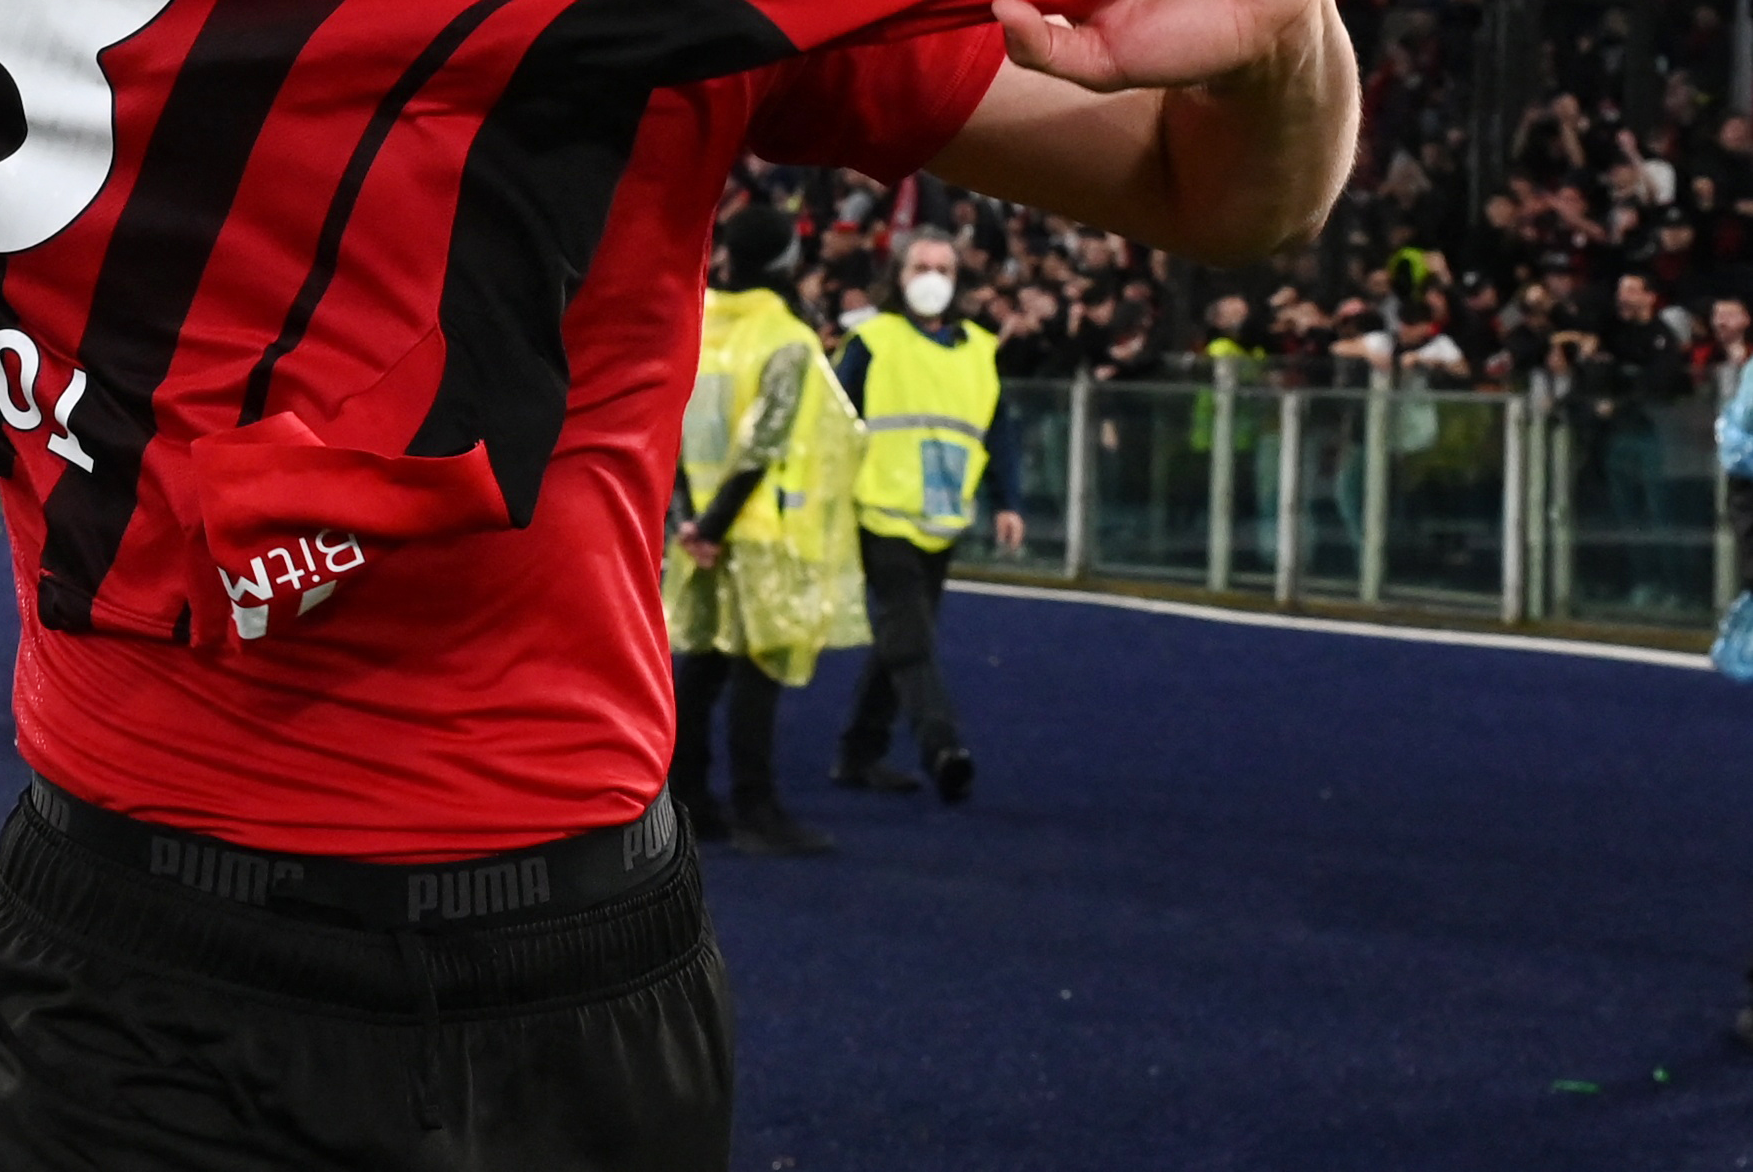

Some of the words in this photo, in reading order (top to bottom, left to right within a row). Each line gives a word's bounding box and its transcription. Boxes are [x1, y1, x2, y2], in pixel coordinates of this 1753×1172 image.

[217, 528, 366, 601] BitM
[623, 798, 674, 872] PUM
[406, 855, 548, 923] PUMA
